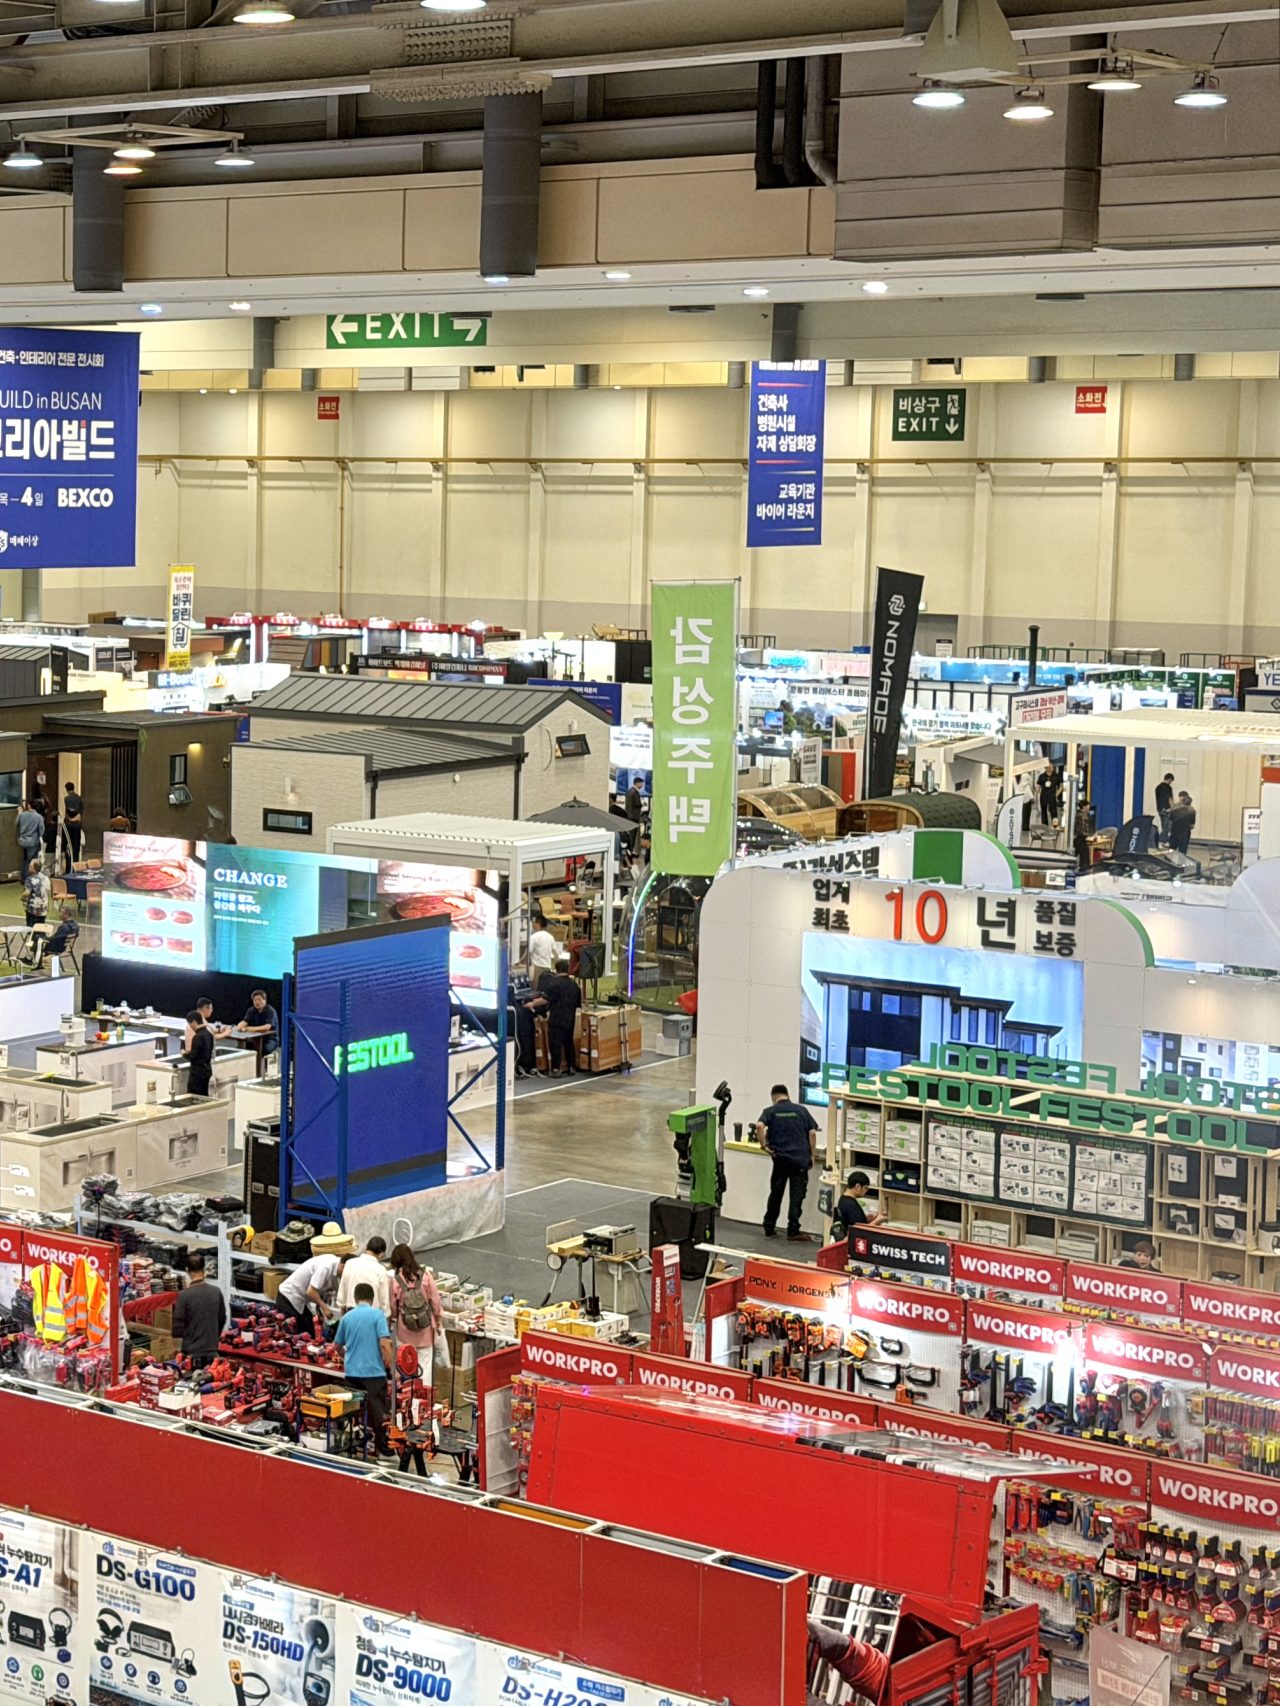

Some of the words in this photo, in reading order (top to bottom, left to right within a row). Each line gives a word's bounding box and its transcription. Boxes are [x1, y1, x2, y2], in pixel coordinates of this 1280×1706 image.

[366, 313, 444, 339] EXIT
[57, 351, 76, 367] 전문
[77, 352, 105, 368] 전시회
[36, 391, 48, 409] in
[51, 392, 102, 411] BUSAN
[757, 394, 789, 411] 건축사
[898, 396, 941, 415] 비상구
[1077, 392, 1102, 403] 소화전
[757, 414, 796, 433] 병원시설
[898, 417, 940, 432] EXIT
[756, 434, 776, 453] 자재
[778, 434, 817, 452] 상담회장
[57, 487, 114, 508] BEXCO
[778, 483, 815, 499] 교육기관
[756, 503, 785, 520] 바이어
[786, 502, 815, 520] 라운지
[872, 620, 900, 735] NOMADE
[213, 868, 288, 889] CHANGE
[812, 907, 850, 932] 최초
[885, 886, 948, 944] 10
[976, 896, 1017, 950] 년
[1033, 900, 1076, 926] 품질
[1033, 929, 1077, 958] 보증
[822, 1062, 1030, 1119] FESTOOL
[1040, 1093, 1269, 1155] FESTOOL
[27, 1242, 99, 1269] WORKPO
[871, 1244, 908, 1260] SWISS
[910, 1249, 946, 1267] TECH
[959, 1254, 1052, 1285] WORKPRO
[1072, 1275, 1168, 1306] WORKPRO
[856, 1294, 951, 1324] WORKPRO
[972, 1313, 1069, 1346] WORKPRO
[525, 1343, 619, 1379] WORKPRO
[1091, 1334, 1195, 1369] WORKPRO
[638, 1367, 736, 1401] WORKPRO
[1157, 1475, 1278, 1517] WORKPRO
[6, 1543, 53, 1570] 누수탐지기
[96, 1553, 196, 1602] DS-G100
[222, 1605, 285, 1636] 내시경카메라
[222, 1620, 305, 1662] DS-150HD
[389, 1645, 447, 1675] 누수탐지기
[355, 1652, 452, 1703] DS-9000
[501, 1675, 608, 1706] DS-H2
